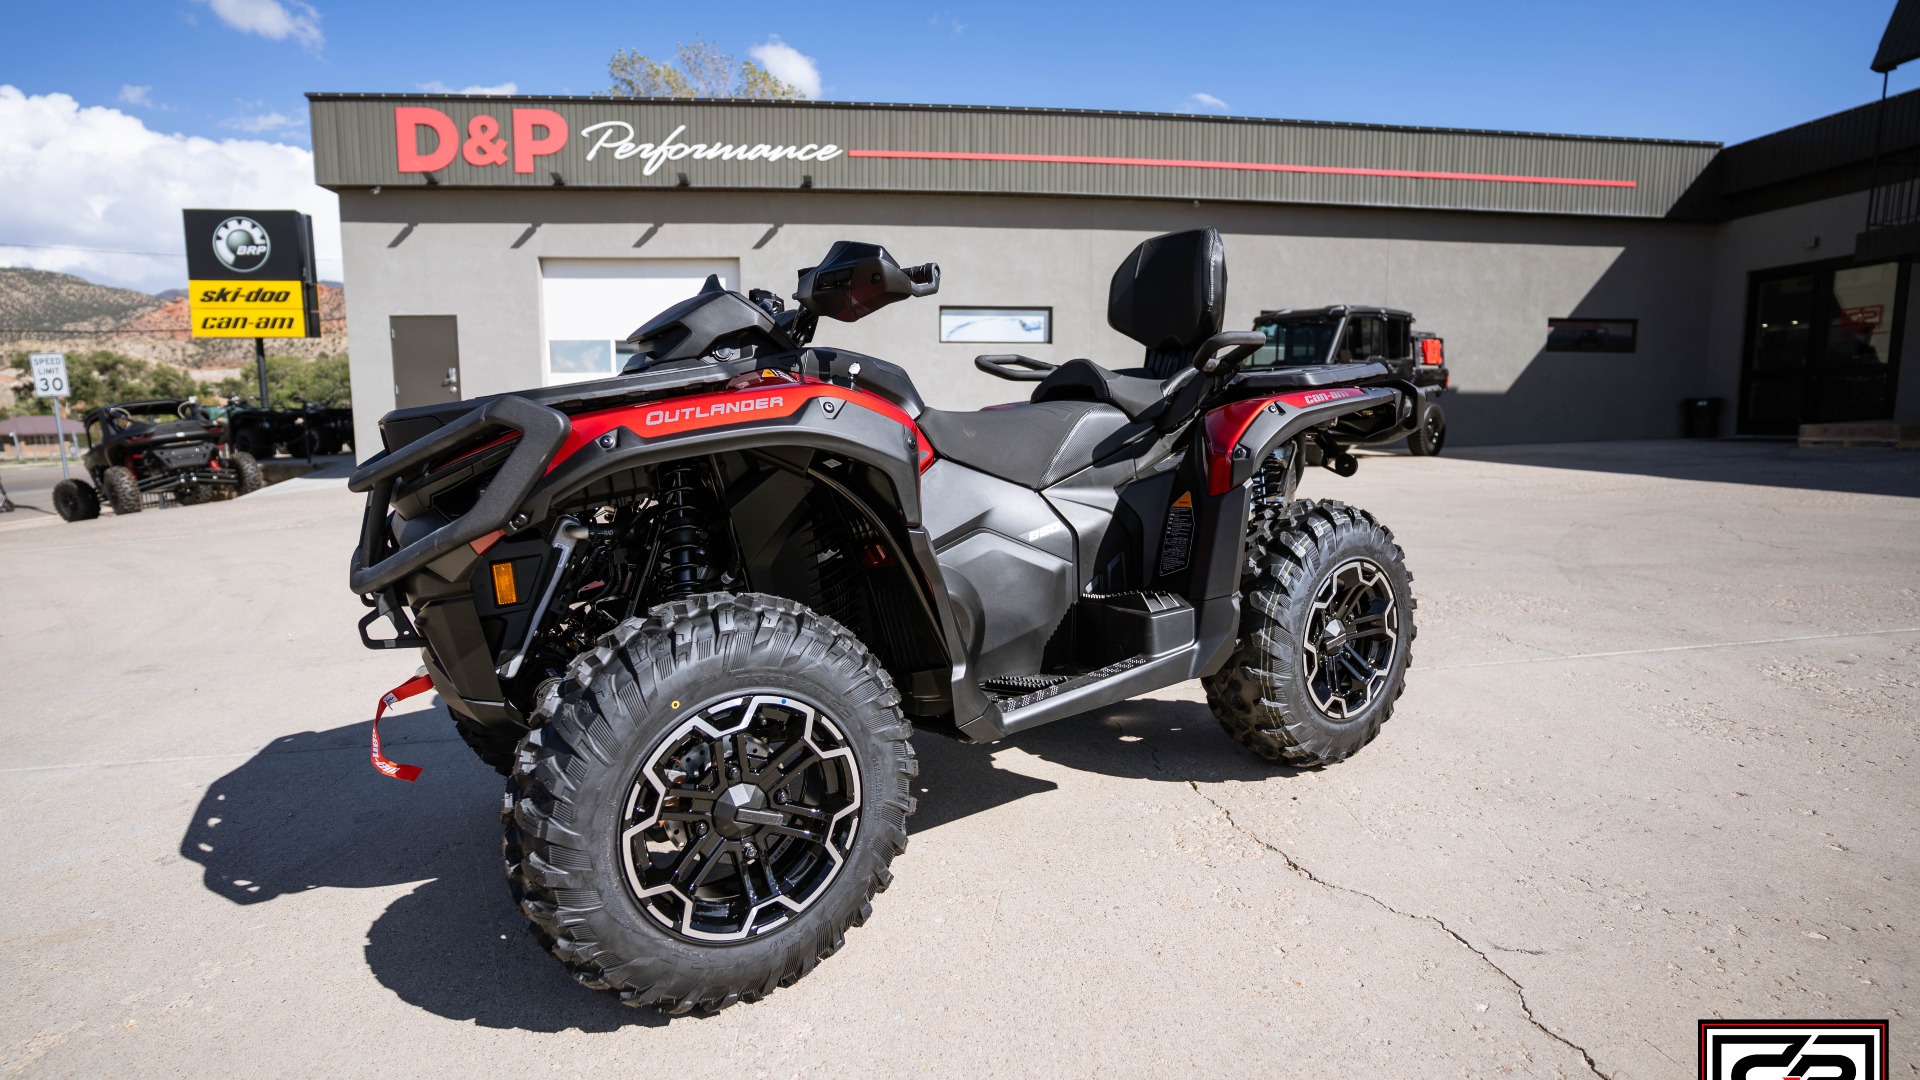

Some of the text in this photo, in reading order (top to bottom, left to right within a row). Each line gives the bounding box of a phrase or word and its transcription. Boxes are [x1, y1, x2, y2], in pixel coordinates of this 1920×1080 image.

[395, 107, 843, 177] D&P Performance
[236, 245, 267, 255] BRP
[200, 287, 291, 302] ski-doo
[201, 317, 295, 329] can-am
[33, 357, 61, 365] SPEED
[38, 367, 60, 375] LIMIT
[40, 377, 63, 391] 30
[1304, 389, 1350, 405] can-am
[645, 396, 784, 427] OUTLANDER
